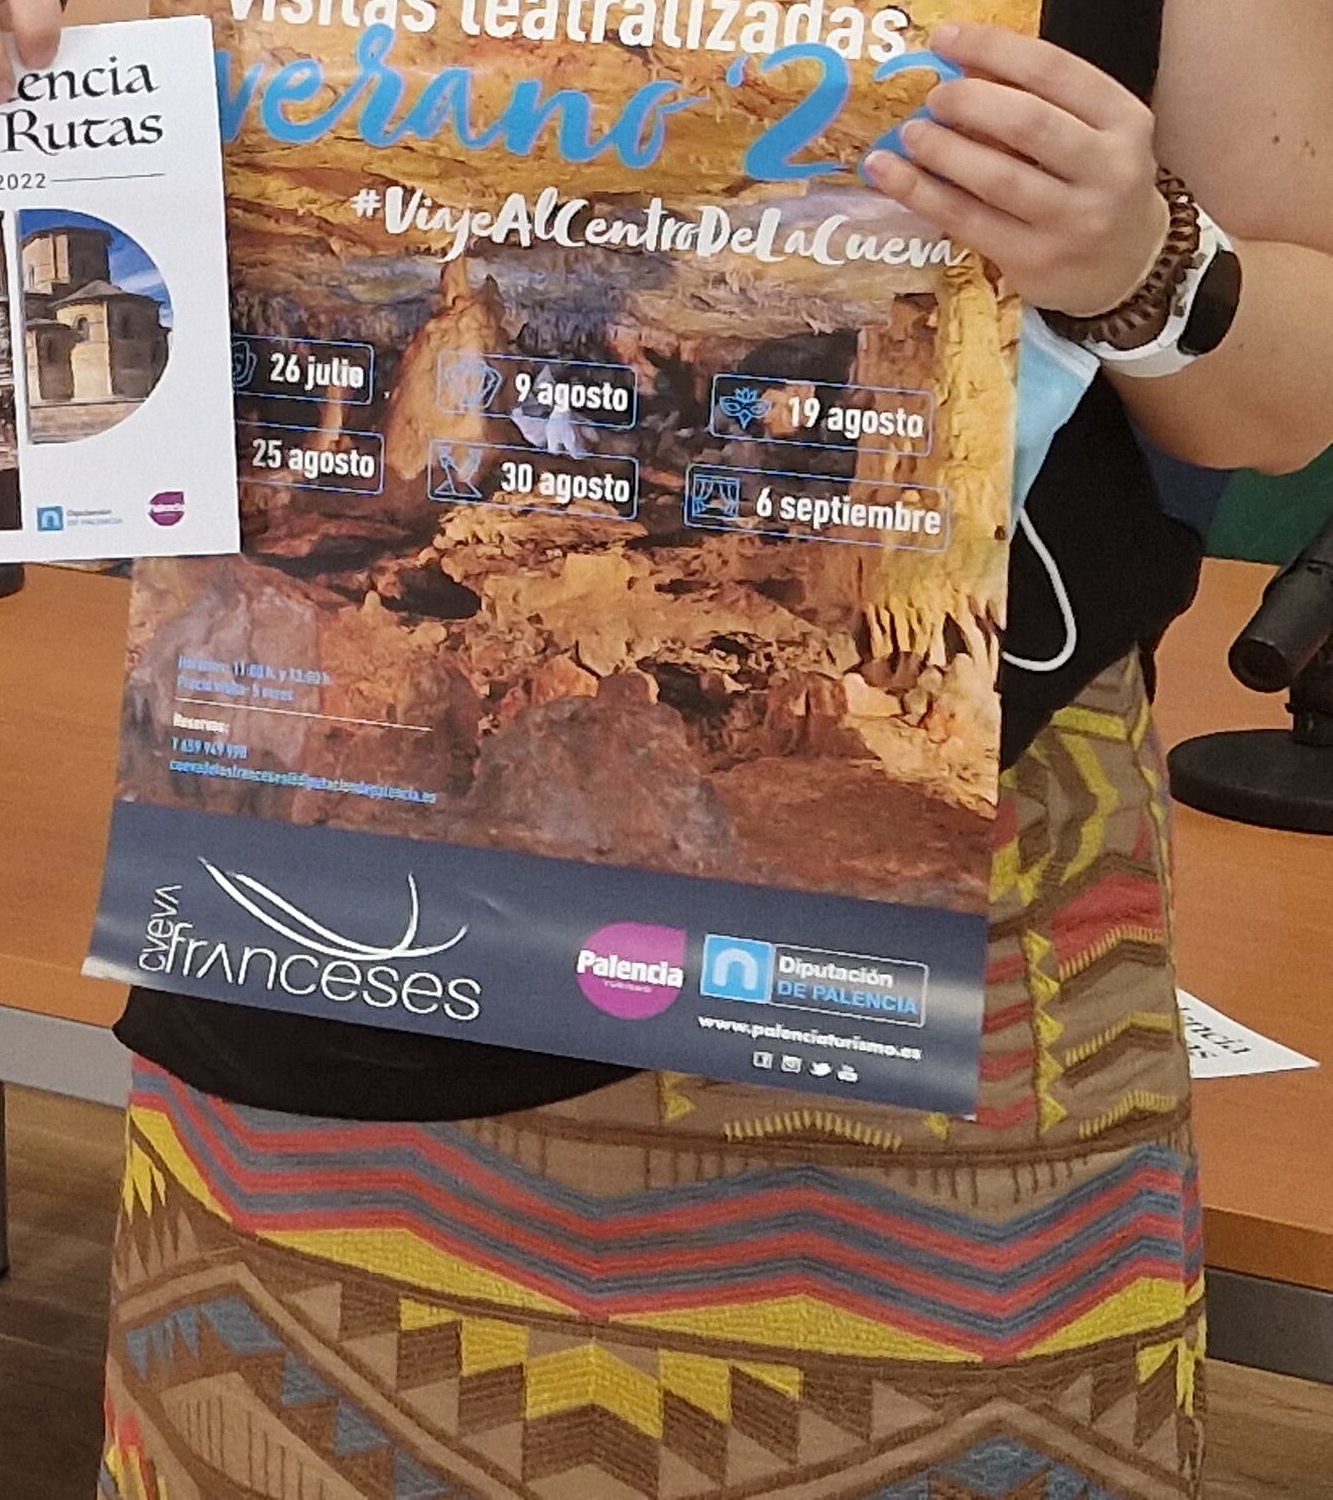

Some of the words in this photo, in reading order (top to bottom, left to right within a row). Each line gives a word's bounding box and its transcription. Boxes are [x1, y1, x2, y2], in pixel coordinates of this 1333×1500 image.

[215, 23, 705, 170] verano
[350, 186, 971, 269] #ViajeAlCentroDeLaCueva
[269, 353, 300, 383] 26
[304, 356, 364, 389] julio
[514, 373, 531, 402] 9
[536, 382, 628, 412] agosto
[787, 396, 821, 428] 19
[827, 407, 924, 439] agosto
[252, 438, 281, 469] 25
[288, 446, 376, 480] agosto
[500, 461, 532, 493] 30
[539, 471, 630, 504] agosto
[756, 487, 773, 517] 6
[780, 495, 941, 535] septiembre
[577, 948, 684, 989] Palencia
[778, 955, 894, 989] Diputación
[777, 980, 804, 998] DE
[812, 985, 919, 1015] PALENCIA
[698, 1014, 922, 1060] www.palenciaturismo.es
